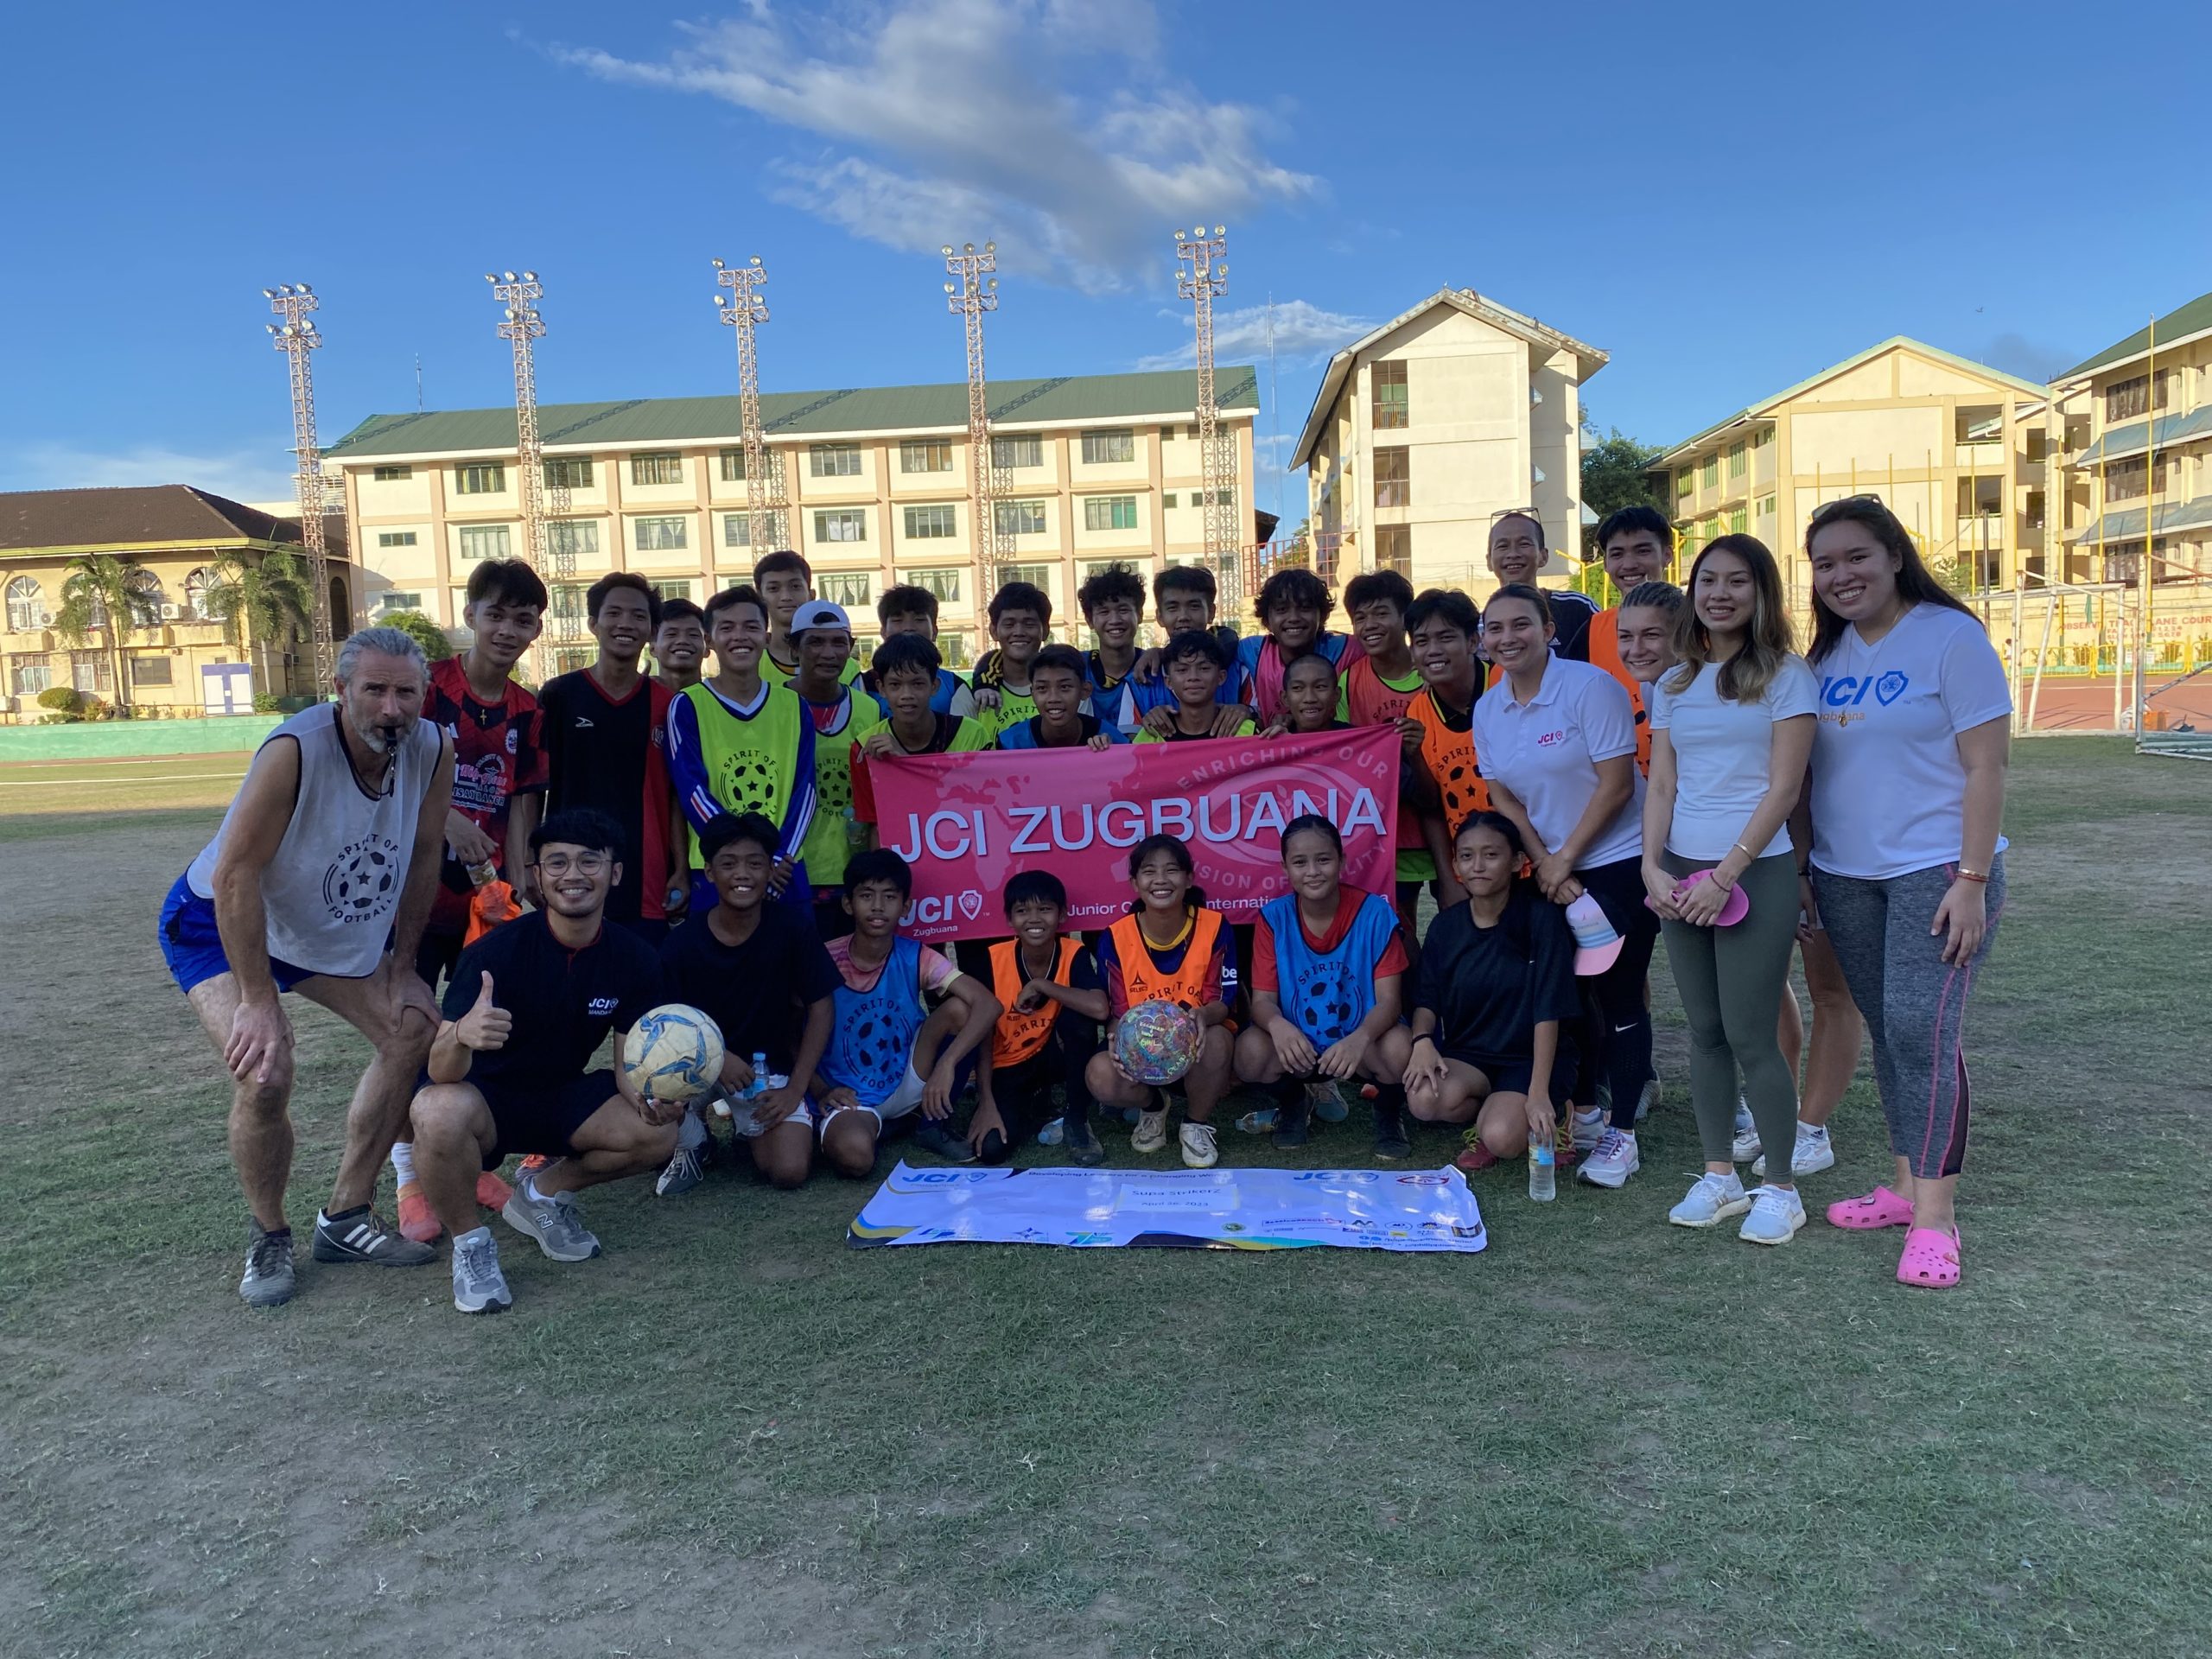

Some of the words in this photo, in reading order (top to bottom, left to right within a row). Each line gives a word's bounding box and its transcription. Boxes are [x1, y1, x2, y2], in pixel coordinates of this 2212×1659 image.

[998, 706, 1038, 724] SPIRIT
[1537, 733, 1554, 744] JCI
[724, 750, 760, 770] SPIRIT
[764, 755, 776, 766] OF
[1177, 746, 1325, 790] ENRICHING
[1338, 746, 1389, 779] OUR
[892, 810, 988, 863] JCI
[1008, 787, 1388, 854] ZUGBUANA
[338, 834, 378, 861] SPIIT
[384, 839, 398, 853] OF
[1262, 876, 1290, 891] OF
[328, 898, 392, 924] FOOTBALL
[899, 895, 954, 926] JCI
[1067, 902, 1116, 917] Junior
[913, 925, 958, 938] Zugbuana
[1298, 961, 1344, 985] SPIRIT
[588, 998, 610, 1009] JCI
[843, 998, 884, 1033] SPIRIT
[901, 1173, 961, 1183] JCI
